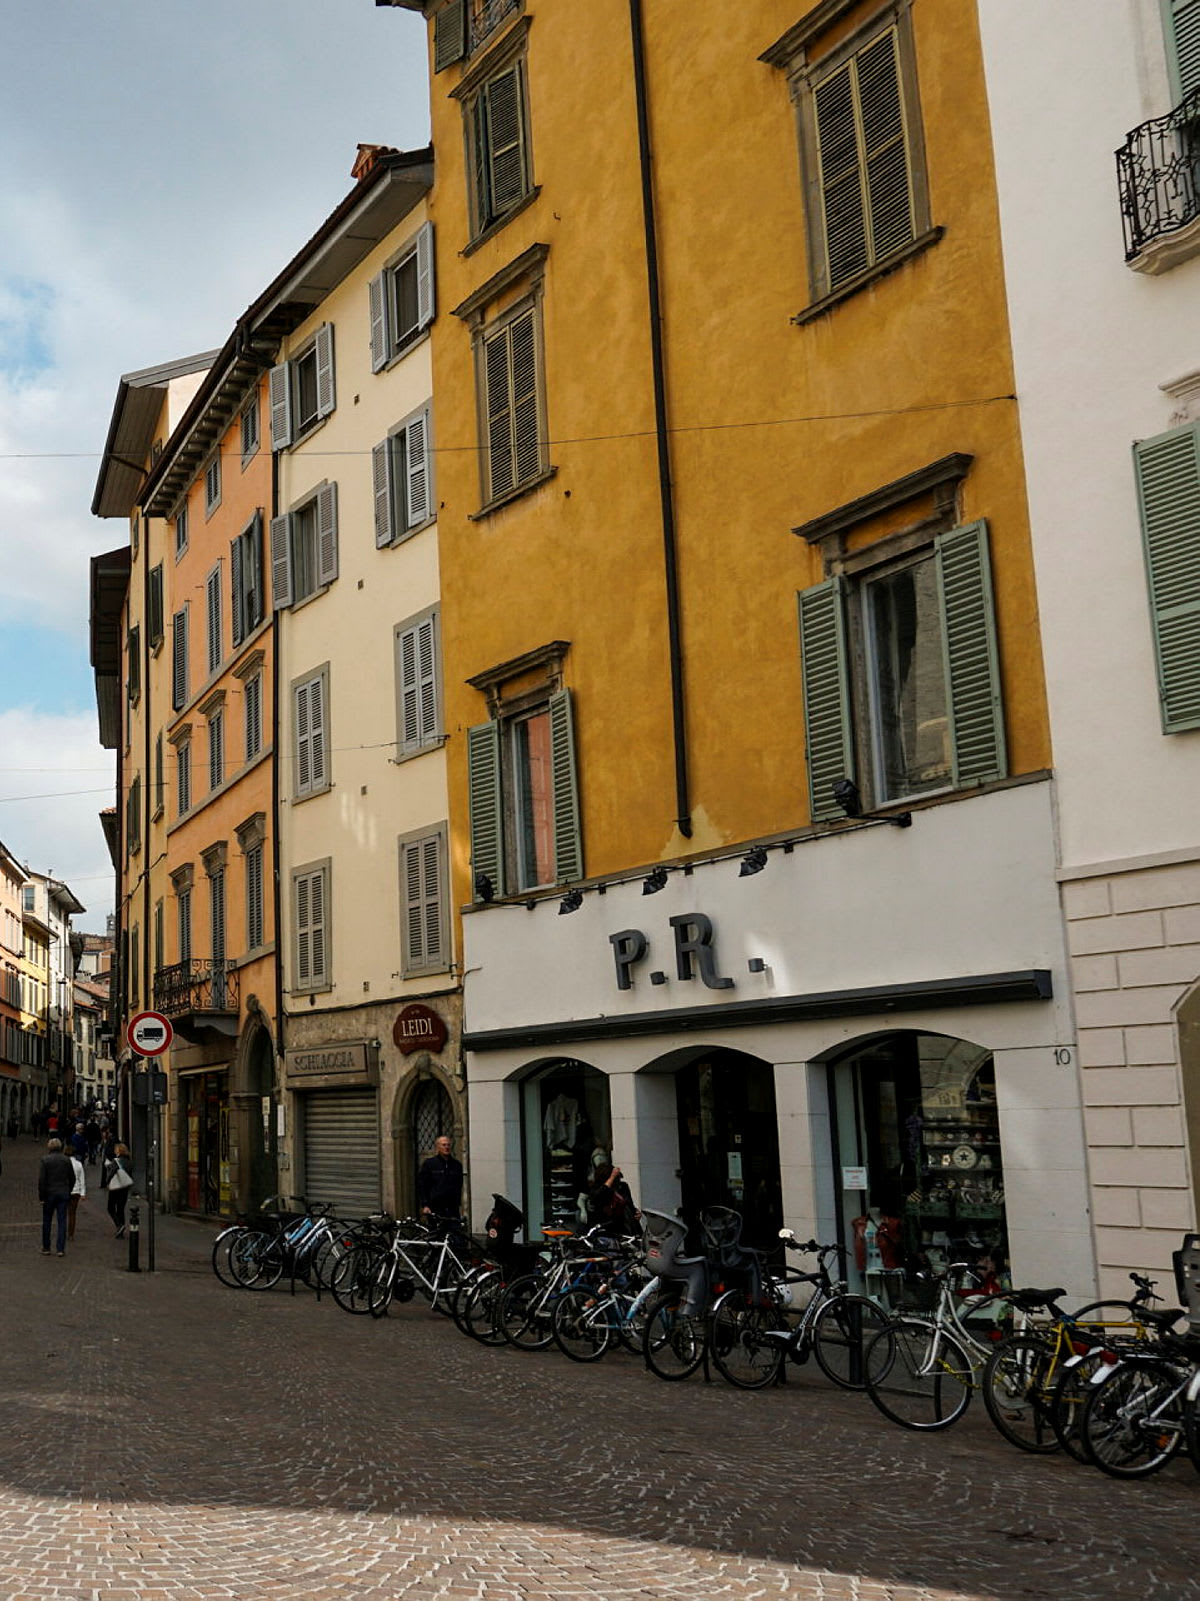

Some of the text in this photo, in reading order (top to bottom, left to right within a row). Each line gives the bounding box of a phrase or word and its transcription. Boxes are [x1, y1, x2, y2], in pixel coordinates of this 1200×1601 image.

[609, 912, 767, 990] P.R.
[400, 1017, 433, 1037] LEIDI
[1053, 1048, 1071, 1066] 10
